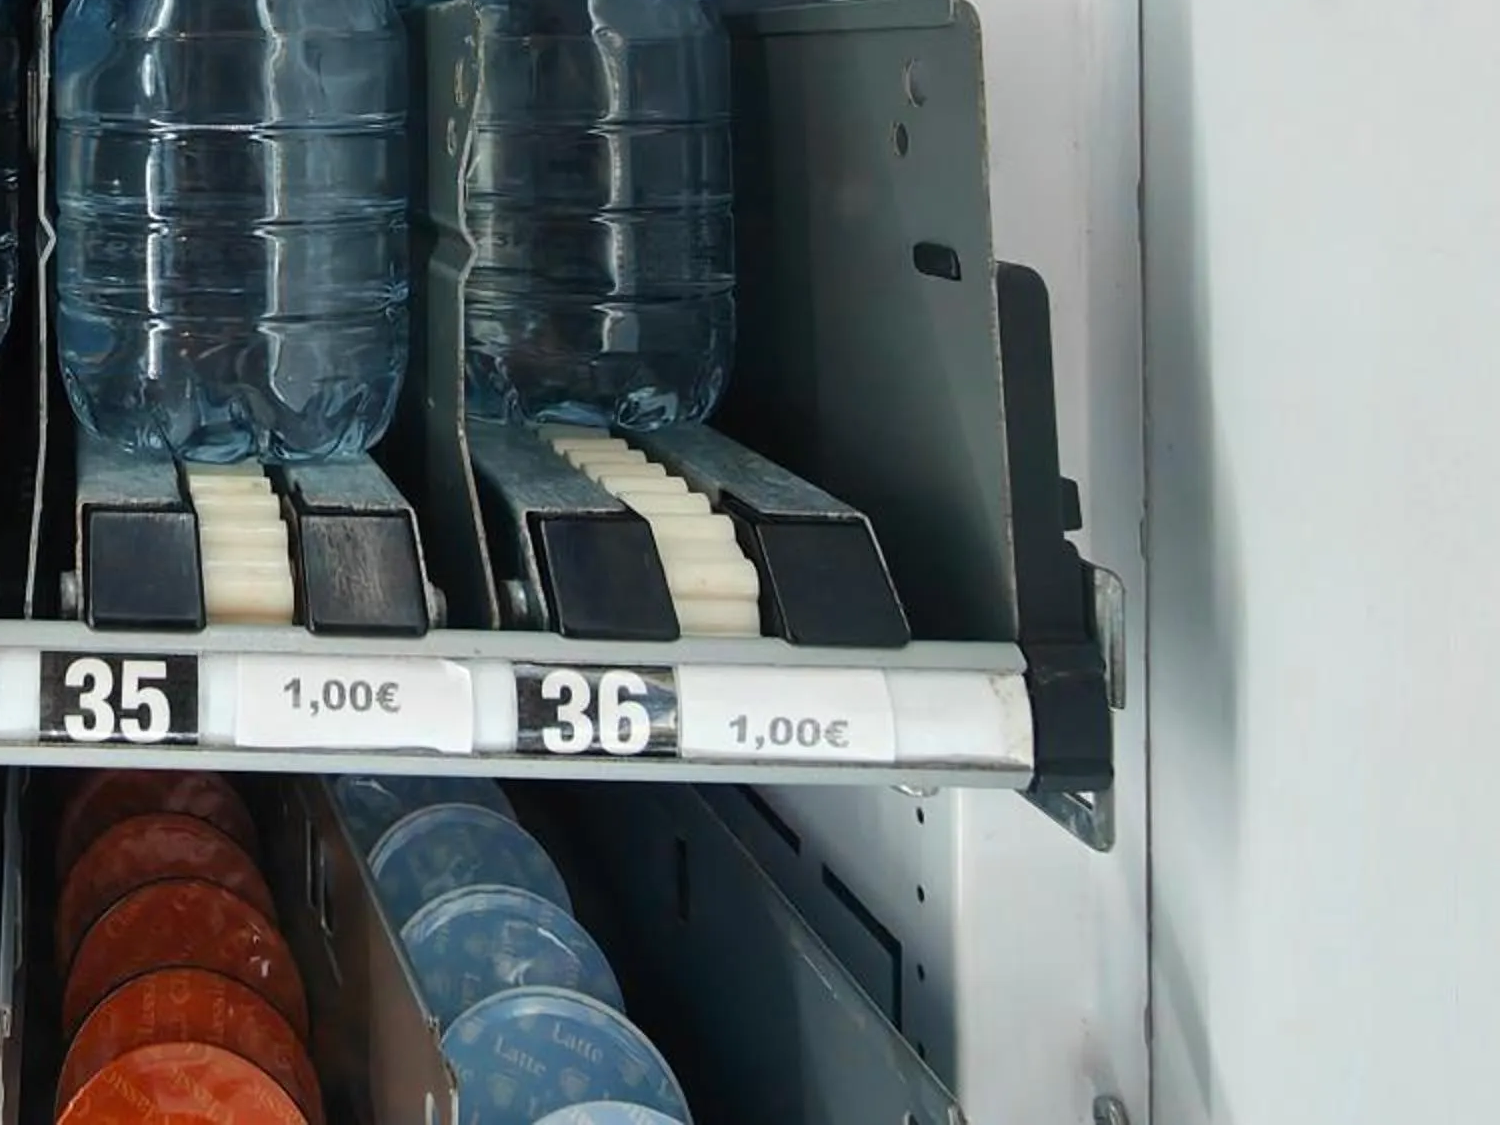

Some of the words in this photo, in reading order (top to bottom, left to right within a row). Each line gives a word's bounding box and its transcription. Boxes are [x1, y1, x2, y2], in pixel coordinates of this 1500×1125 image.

[63, 657, 171, 744] 35
[283, 678, 401, 718] 1,00€
[541, 669, 650, 756] 36
[728, 715, 851, 749] 1,00€
